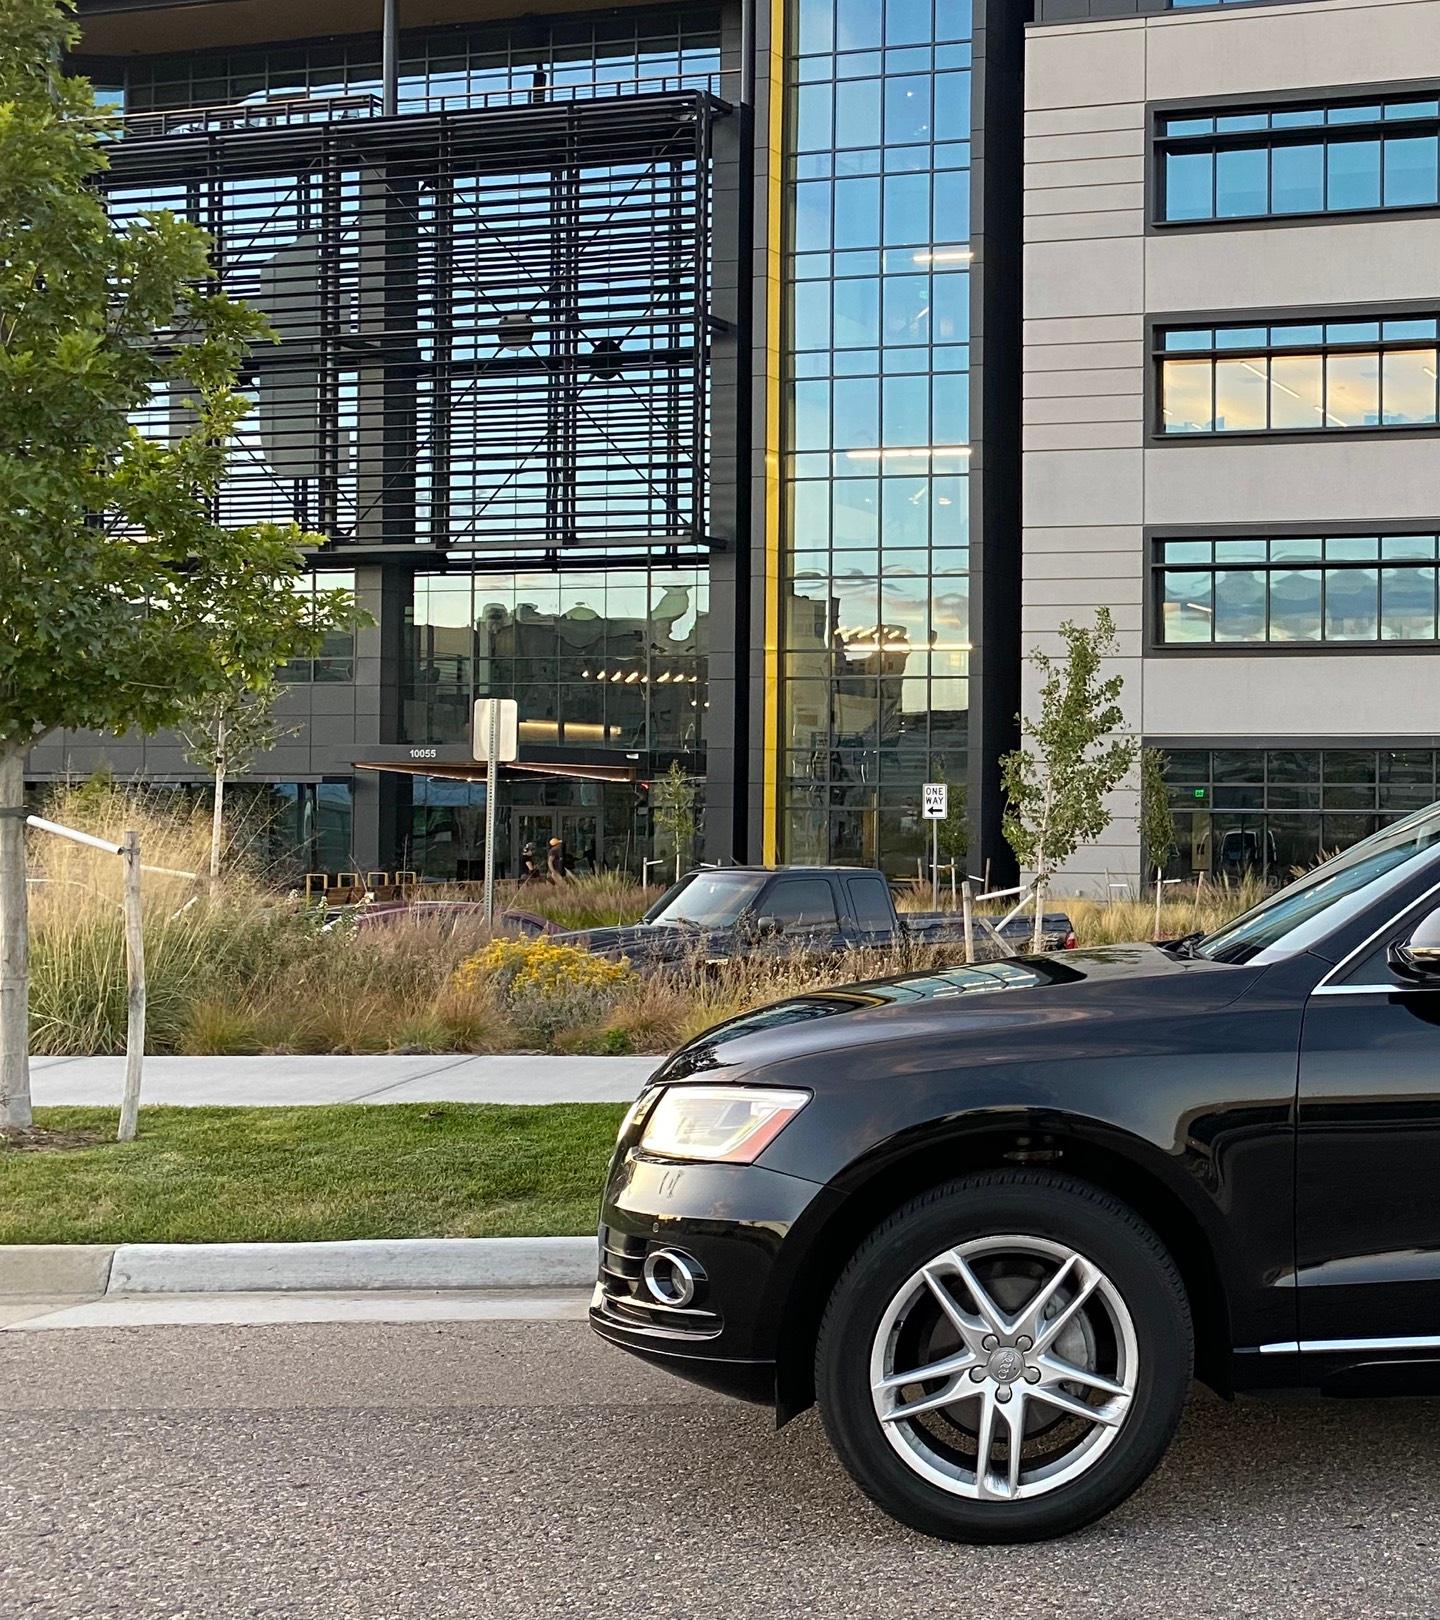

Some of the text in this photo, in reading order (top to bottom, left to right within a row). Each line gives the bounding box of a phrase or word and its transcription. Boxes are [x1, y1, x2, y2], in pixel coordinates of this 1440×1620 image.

[409, 749, 437, 758] 10055
[925, 787, 944, 796] ONE
[925, 796, 944, 805] WAY
